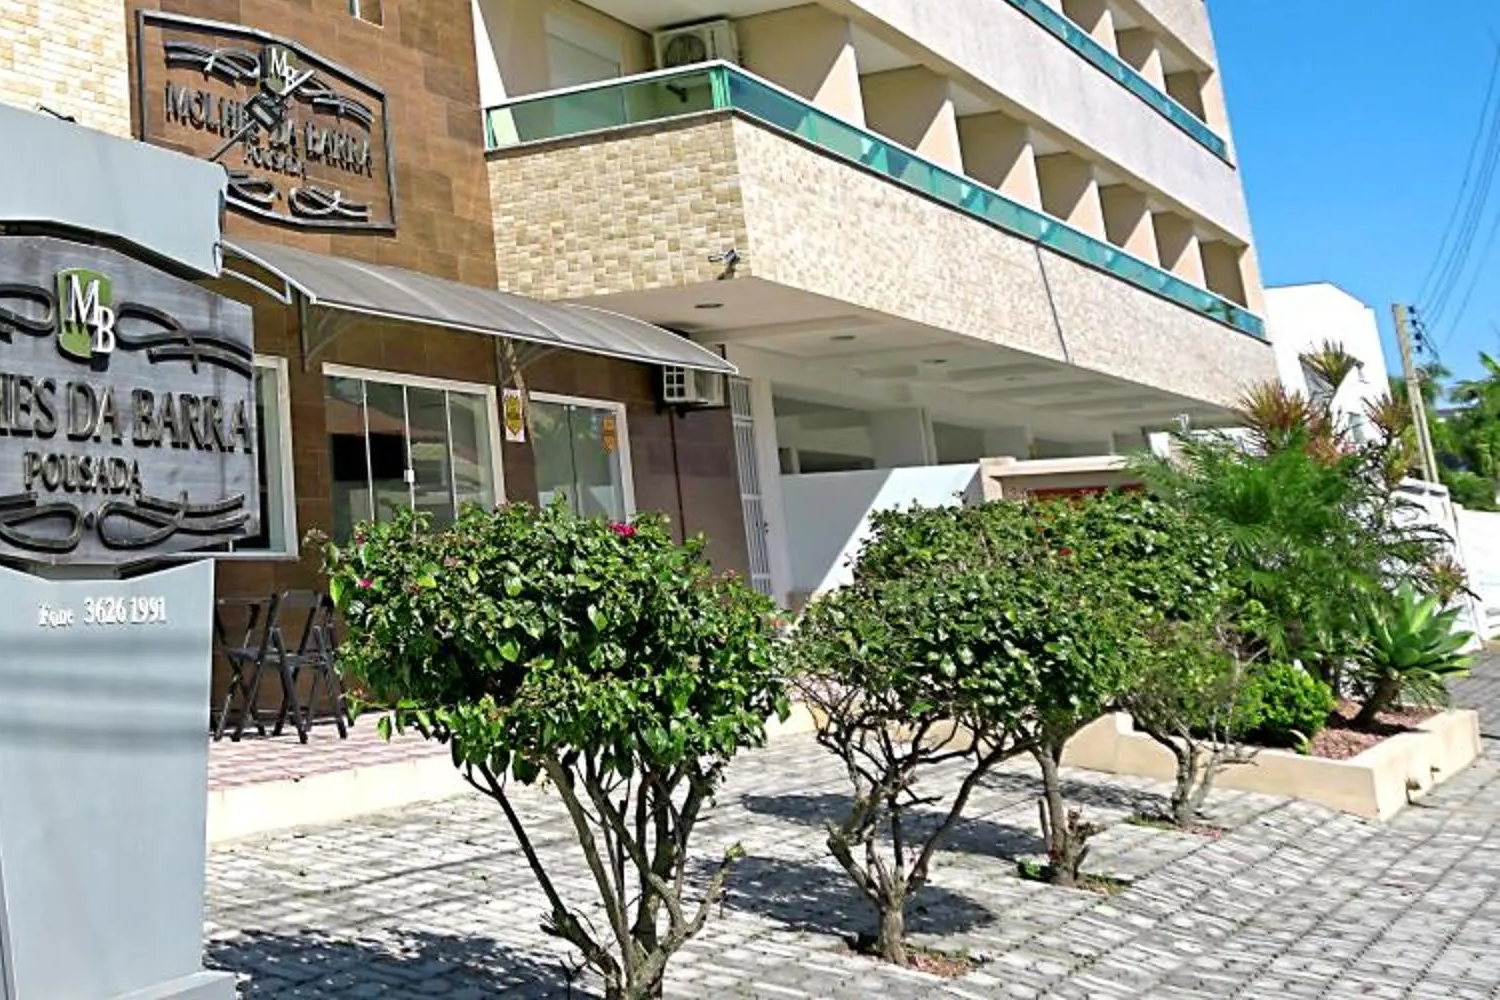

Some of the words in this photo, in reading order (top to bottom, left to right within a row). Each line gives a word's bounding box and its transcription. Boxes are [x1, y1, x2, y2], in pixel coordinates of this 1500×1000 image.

[66, 273, 116, 353] MB
[67, 381, 123, 446] DA
[131, 388, 253, 454] BARRA
[24, 451, 144, 496] POUSADA
[84, 596, 127, 624] 3626
[129, 596, 167, 624] 1991
